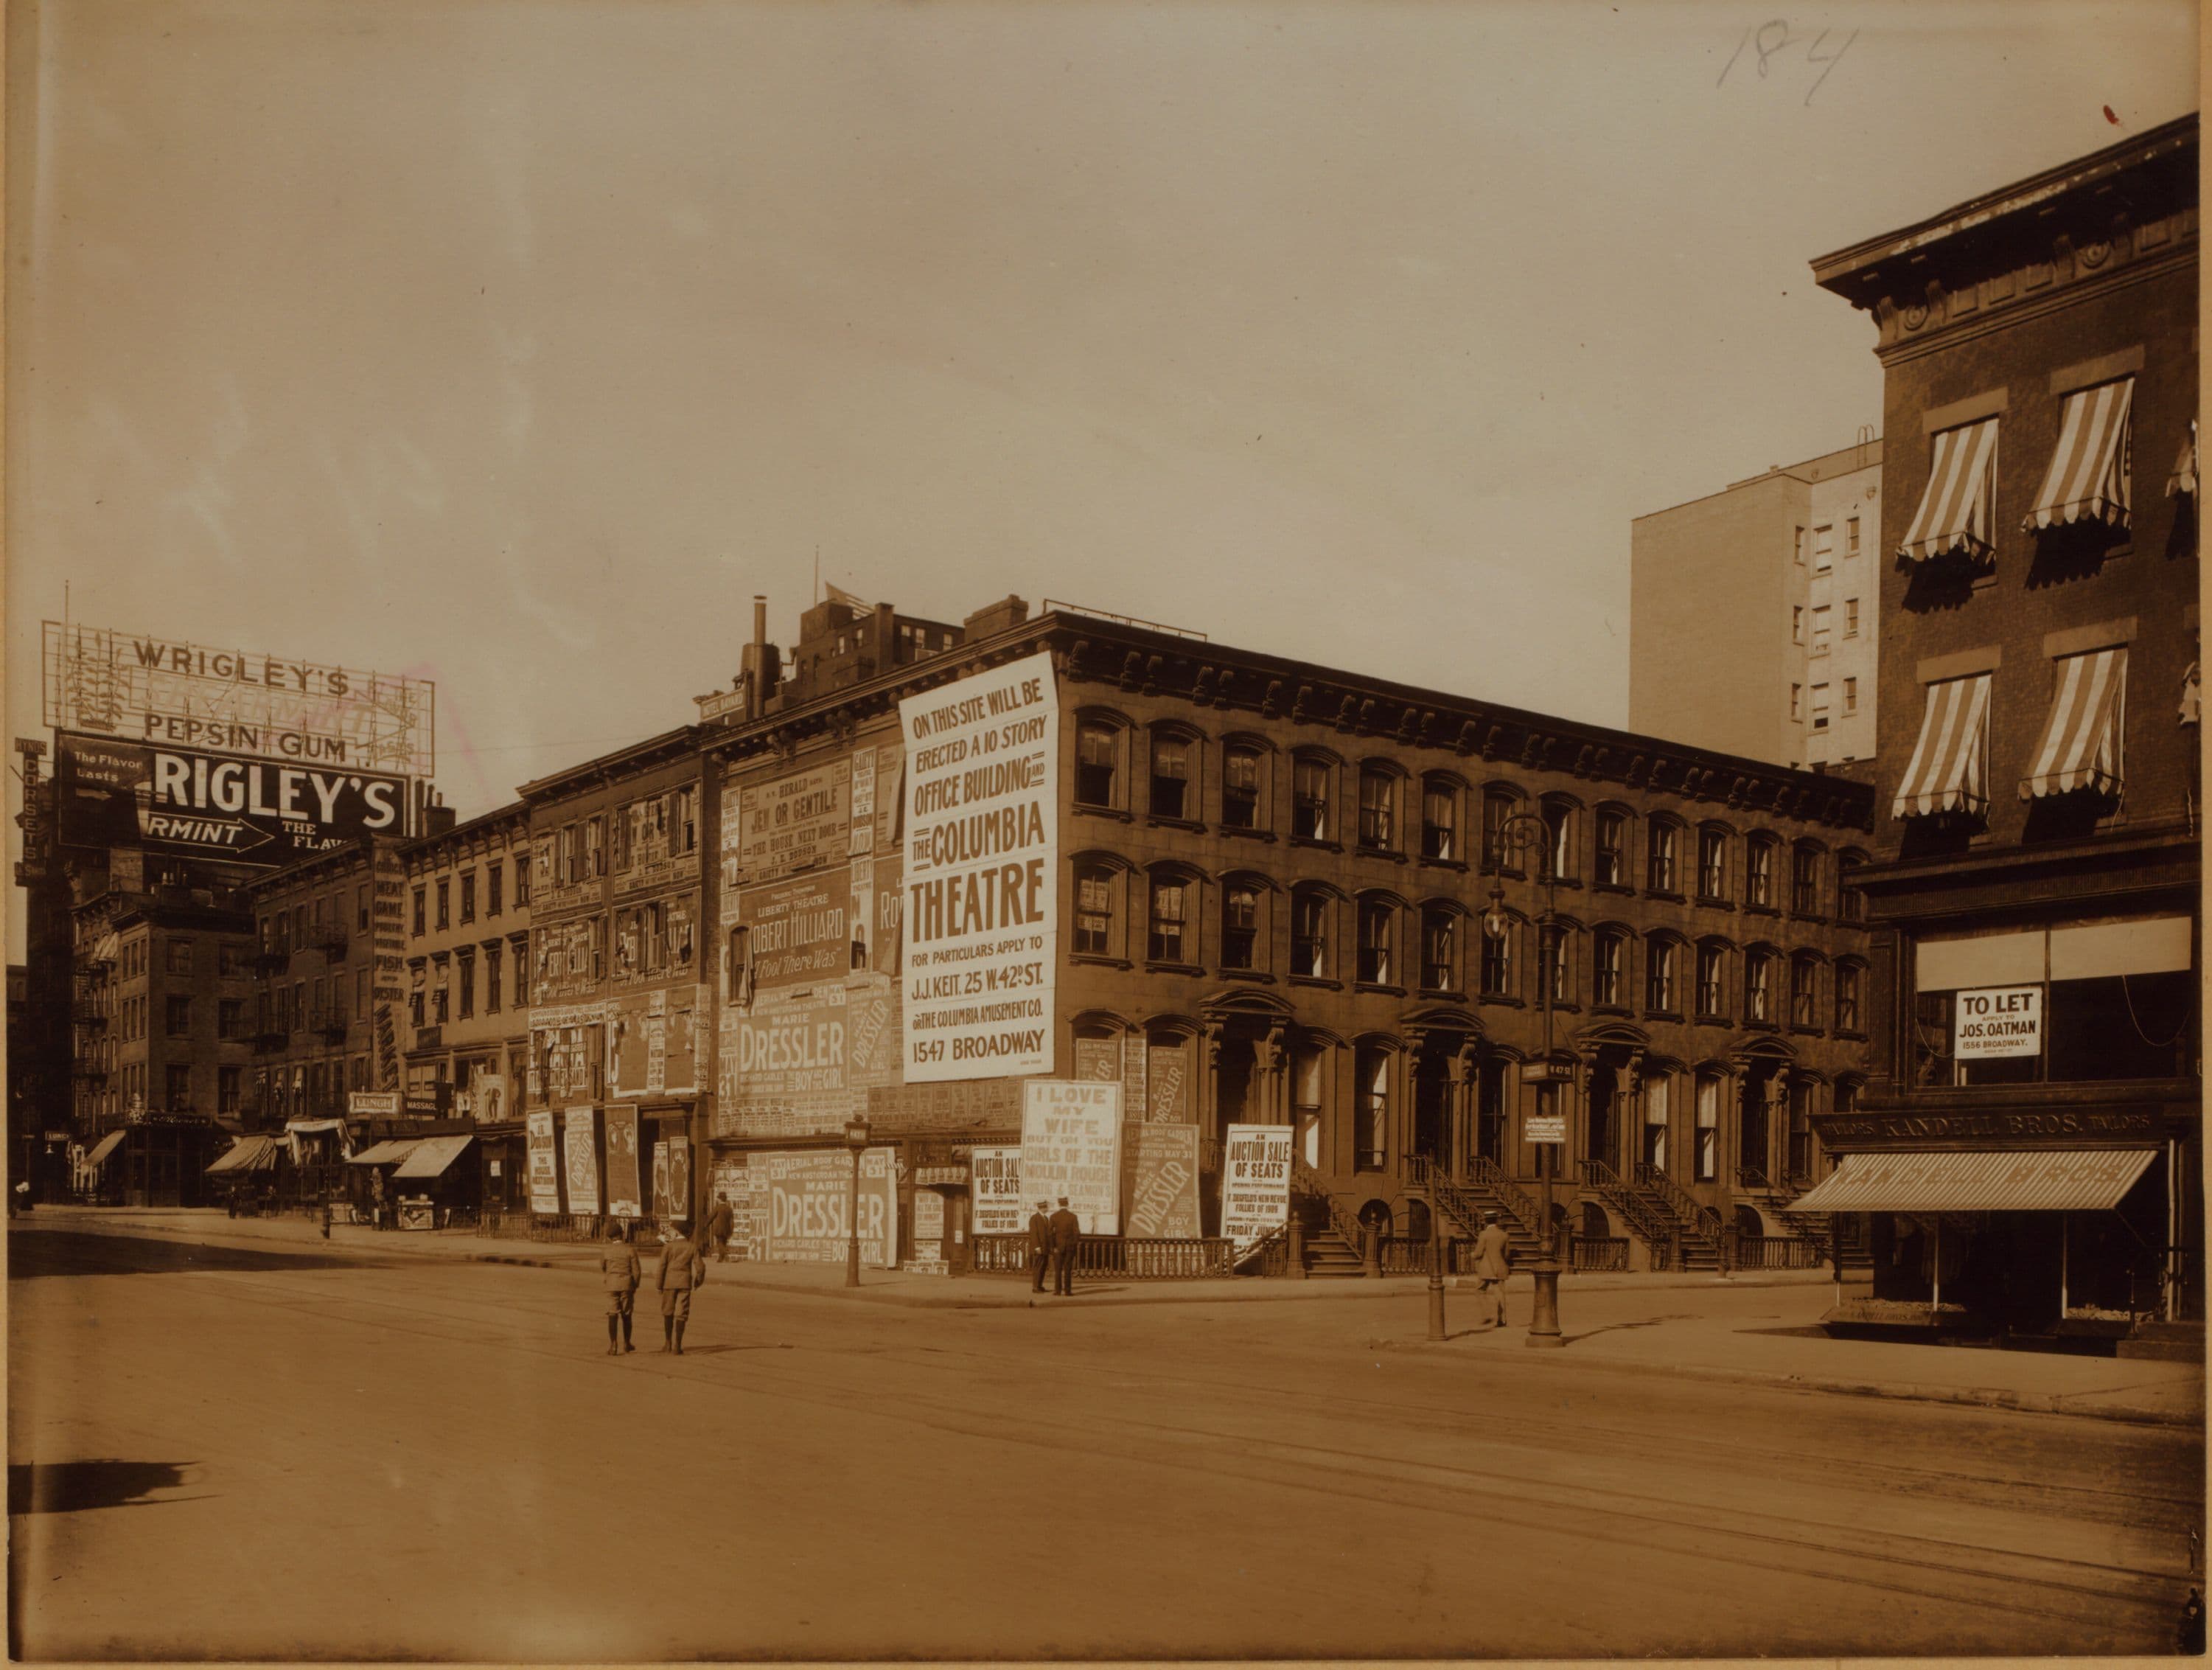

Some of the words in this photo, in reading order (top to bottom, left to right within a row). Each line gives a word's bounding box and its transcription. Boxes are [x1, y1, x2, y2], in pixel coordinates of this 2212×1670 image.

[1716, 18, 1860, 107] 184
[132, 639, 349, 695] WRIGLEY'S
[913, 713, 931, 739] ON
[930, 704, 958, 733] THIS
[958, 695, 986, 725] SITE
[987, 684, 1022, 717] WILL
[1021, 677, 1044, 706] BE
[144, 712, 259, 750] PEPSIN
[278, 731, 346, 762] GUM
[916, 739, 967, 773] ERECTED
[971, 734, 980, 758] A
[984, 729, 998, 754] 10
[1001, 714, 1047, 749] STORY
[74, 751, 96, 763] The
[99, 755, 142, 769] Flavor
[77, 768, 119, 782] Lasts
[915, 774, 960, 816] OFFICE
[964, 755, 1032, 804] BUILDING
[1032, 762, 1044, 777] AND
[779, 778, 808, 799] HERALD
[24, 759, 37, 860] CORSETS
[751, 808, 770, 832] JEW
[775, 801, 789, 824] OR
[793, 787, 838, 821] GENTILE
[282, 821, 317, 835] THE
[913, 838, 930, 861] THE
[932, 800, 1045, 866] COLUMBIA
[752, 841, 767, 857] THE
[770, 834, 794, 852] HOUSE
[798, 827, 816, 843] NEXT
[819, 822, 837, 840] DOOR
[789, 845, 817, 860] DODSON
[376, 901, 402, 915] GAME
[758, 902, 790, 918] LIBERTY
[792, 893, 830, 909] THEATRE
[910, 857, 1044, 943] THEATRE
[790, 908, 844, 947] HILLIARD
[912, 953, 928, 967] FOR
[932, 943, 994, 964] PARTICULARS
[996, 938, 1025, 956] APPLY
[1029, 936, 1042, 950] TO
[375, 956, 402, 969] FISH
[761, 956, 780, 978] Fool
[784, 954, 812, 974] There
[964, 970, 982, 994] 25
[986, 967, 998, 992] W.
[1024, 961, 1043, 987] ST.
[1963, 996, 1990, 1015] TO
[1995, 992, 2034, 1014] LET
[772, 1013, 810, 1026] MARIE
[913, 1015, 921, 1031] OR
[921, 1011, 936, 1030] THE
[938, 1006, 979, 1028] COLUMBIA
[980, 1000, 1027, 1023] AMUSEMENT
[1028, 998, 1043, 1017] CO.
[851, 999, 889, 1068] DRESSLER
[1959, 1023, 1986, 1038] JOS.
[1987, 1020, 2036, 1037] OATMAN
[741, 1020, 844, 1072] DRESSLER
[913, 1040, 945, 1063] 1547
[953, 1029, 1045, 1061] BROADWAY
[1963, 1041, 1981, 1050] 1556
[795, 1070, 813, 1092] BOY
[823, 1068, 844, 1089] GIRL
[1036, 1088, 1043, 1103] I
[1049, 1087, 1106, 1104] LOVE
[1152, 1067, 1184, 1124] DRESSLER
[1053, 1106, 1085, 1116] MY
[1044, 1118, 1099, 1135] WIFE
[1880, 1116, 1998, 1138] KANDELL
[2005, 1113, 2084, 1135] BROS.
[2087, 1113, 2150, 1131] TAILORS
[1027, 1135, 1052, 1144] BUT
[1087, 1138, 1114, 1147] YOU
[1231, 1141, 1265, 1162] AUCTION
[1268, 1142, 1289, 1162] SALE
[538, 1156, 547, 1165] THE
[786, 1157, 812, 1172] AERIAL
[834, 1155, 865, 1169] GARDN
[1025, 1147, 1060, 1163] GIRLS
[1064, 1147, 1078, 1163] OF
[1086, 1148, 1112, 1165] THE
[1126, 1149, 1163, 1158] STARTING
[1165, 1149, 1181, 1158] MAY
[975, 1158, 1004, 1178] AUCTION
[1025, 1164, 1068, 1180] MOULIN
[1070, 1165, 1112, 1181] ROUGE
[1235, 1163, 1248, 1177] OF
[1251, 1163, 1283, 1178] SEATS
[806, 1181, 848, 1191] MARIE
[980, 1180, 991, 1194] OF
[993, 1178, 1021, 1194] SEATS
[1129, 1161, 1192, 1235] DRESSLER
[1235, 1204, 1255, 1213] FOLLIES
[1257, 1205, 1263, 1213] OF
[1258, 1194, 1269, 1203] NEW
[1270, 1194, 1286, 1203] REVUE
[772, 1186, 885, 1239] DRESSLER
[1168, 1216, 1190, 1226] BOY
[1227, 1225, 1253, 1236] FRIDAY
[859, 1242, 883, 1263] GIRL
